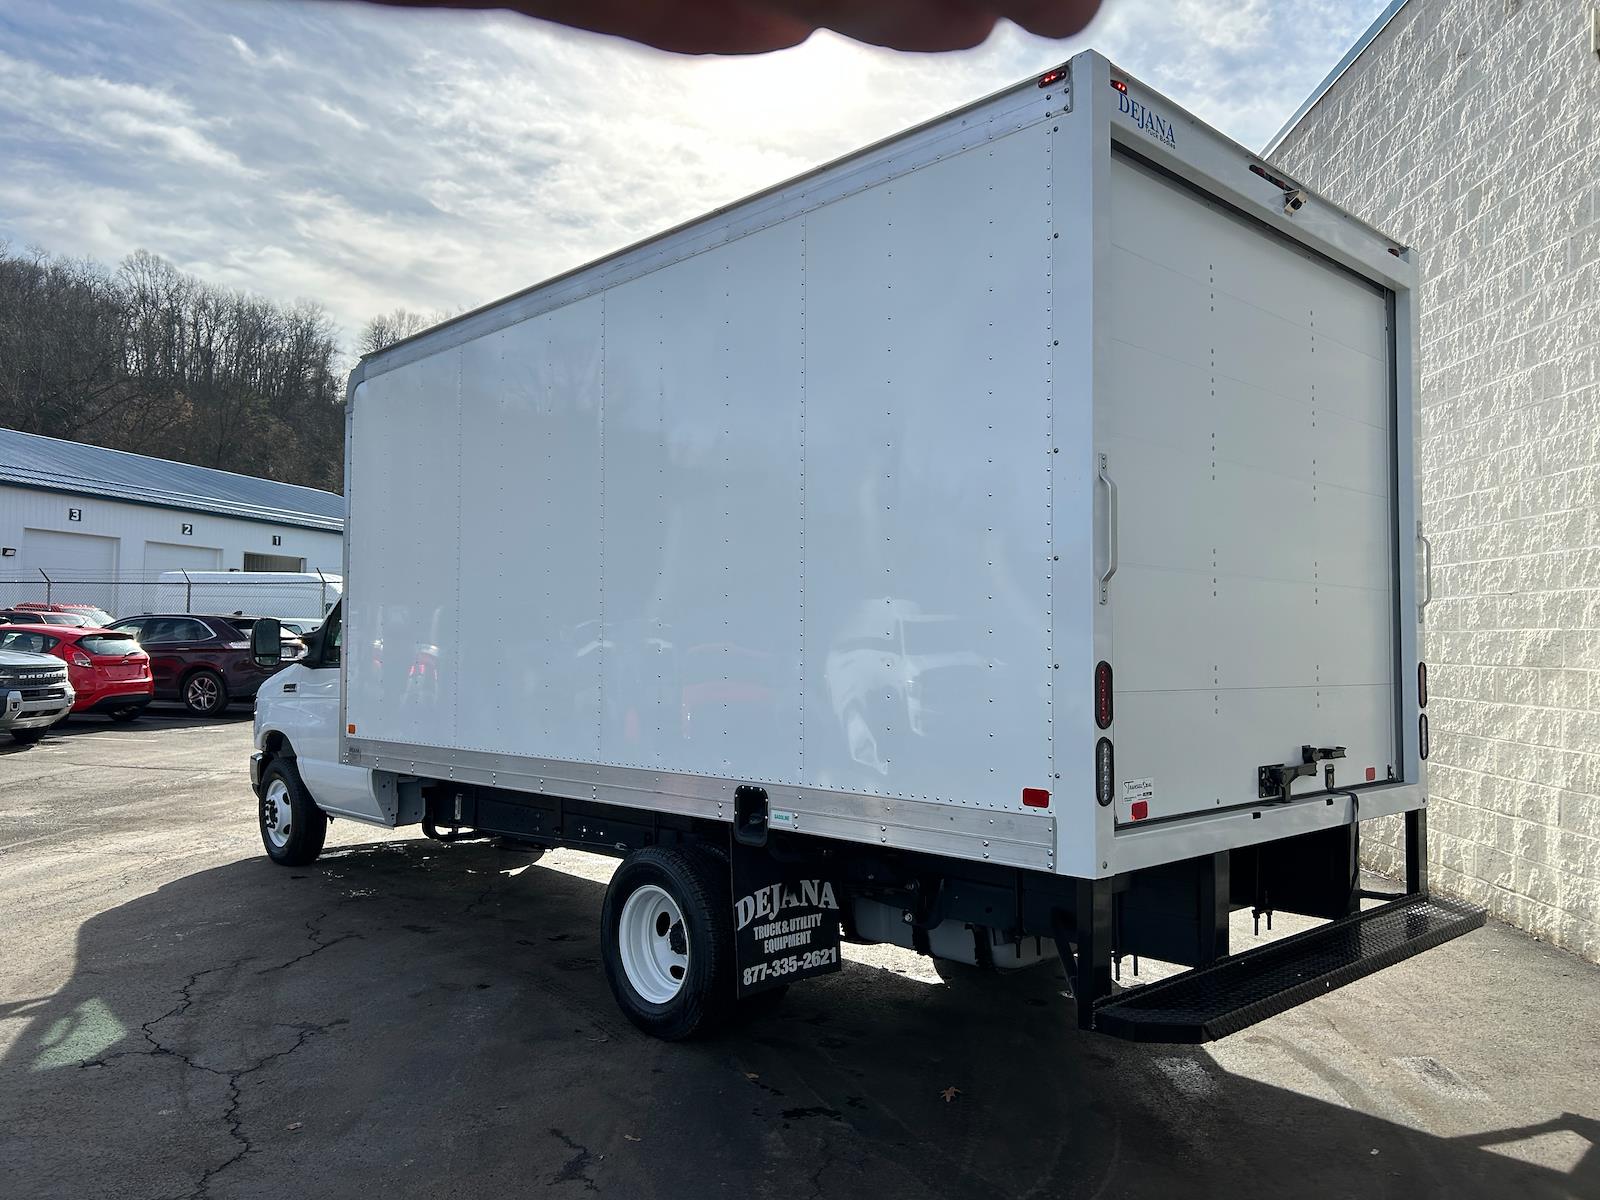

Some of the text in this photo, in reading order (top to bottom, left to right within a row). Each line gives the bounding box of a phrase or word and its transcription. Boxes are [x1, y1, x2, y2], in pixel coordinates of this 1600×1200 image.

[1118, 92, 1176, 143] DEJANA
[71, 509, 80, 520] 3
[184, 524, 191, 535] 2
[735, 880, 840, 931] DEJANA
[753, 921, 782, 940] TRUCK
[790, 913, 822, 932] UTILITY
[764, 931, 812, 953] EQUIPMENT
[743, 946, 837, 986] 877-335-2621
